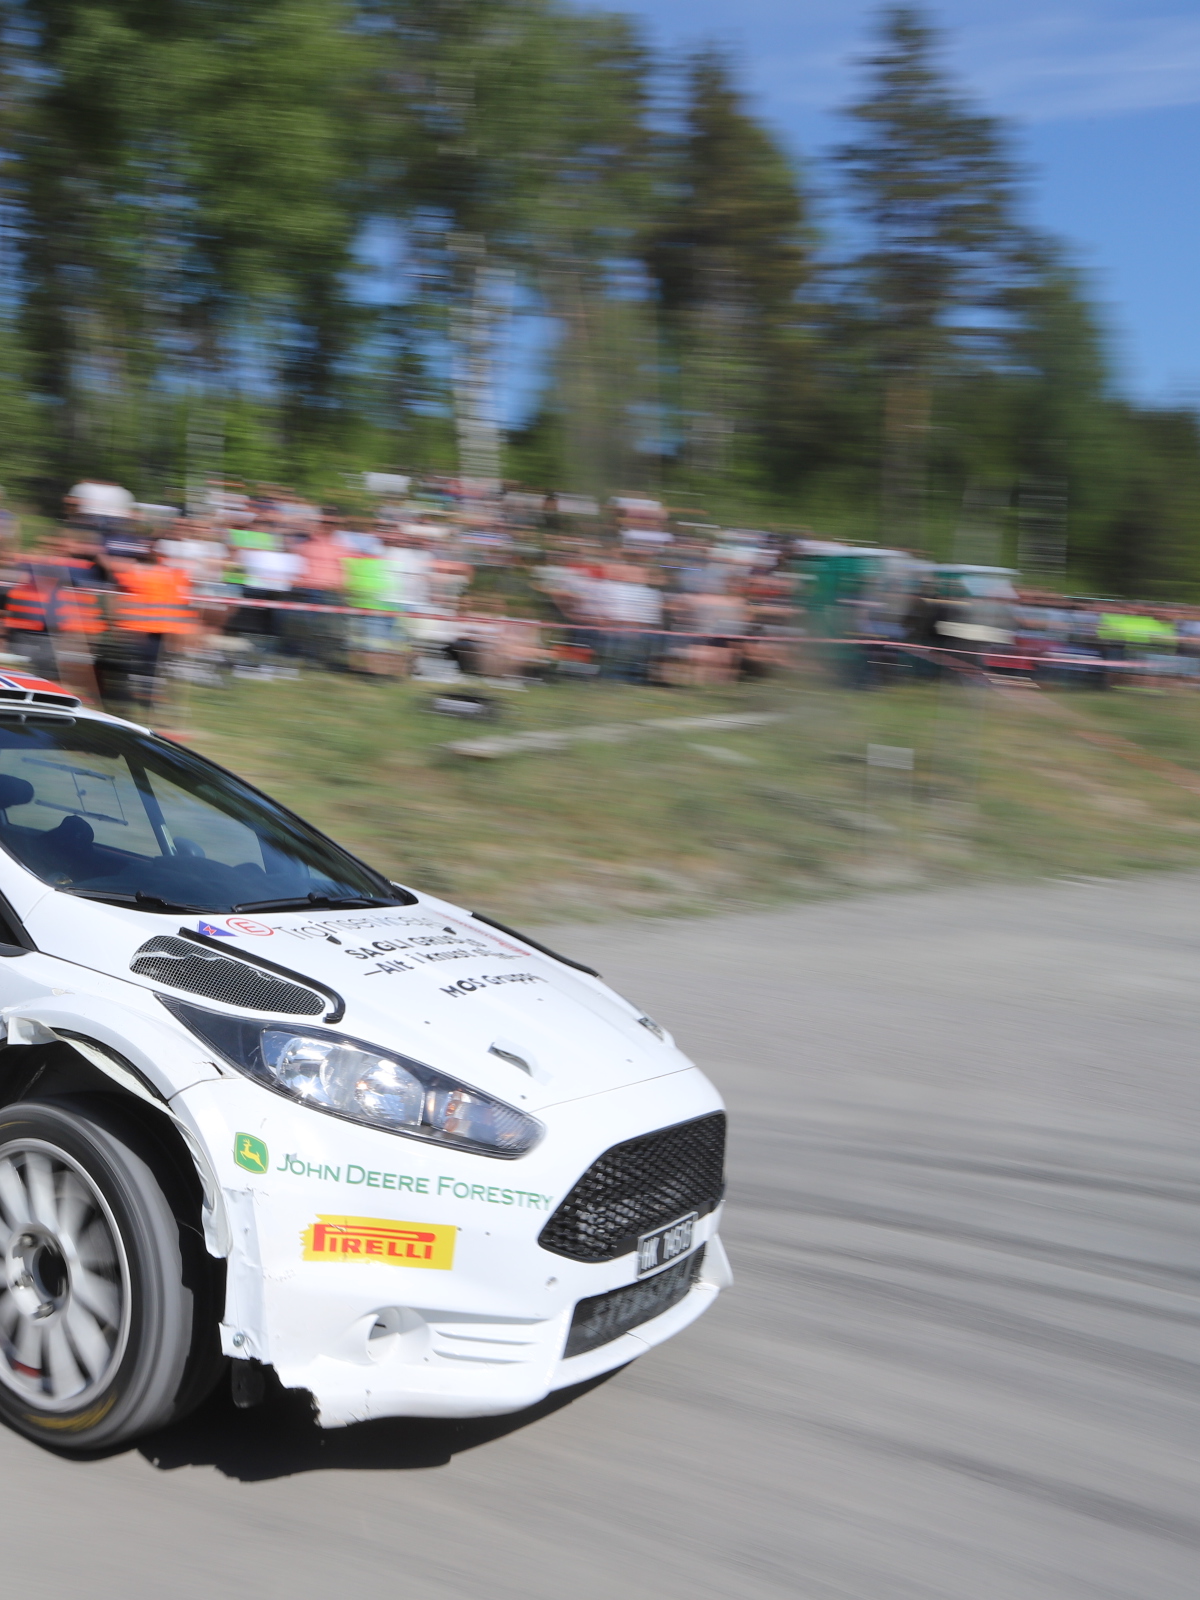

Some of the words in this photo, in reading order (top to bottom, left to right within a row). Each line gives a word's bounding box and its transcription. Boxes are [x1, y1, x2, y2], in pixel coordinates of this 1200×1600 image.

[344, 938, 416, 960] SAGLI
[438, 977, 488, 998] MOS
[276, 1155, 341, 1183] JOHN
[346, 1164, 430, 1195] DEERE
[435, 1176, 554, 1211] FORESTRY
[311, 1223, 437, 1261] PIRELLI
